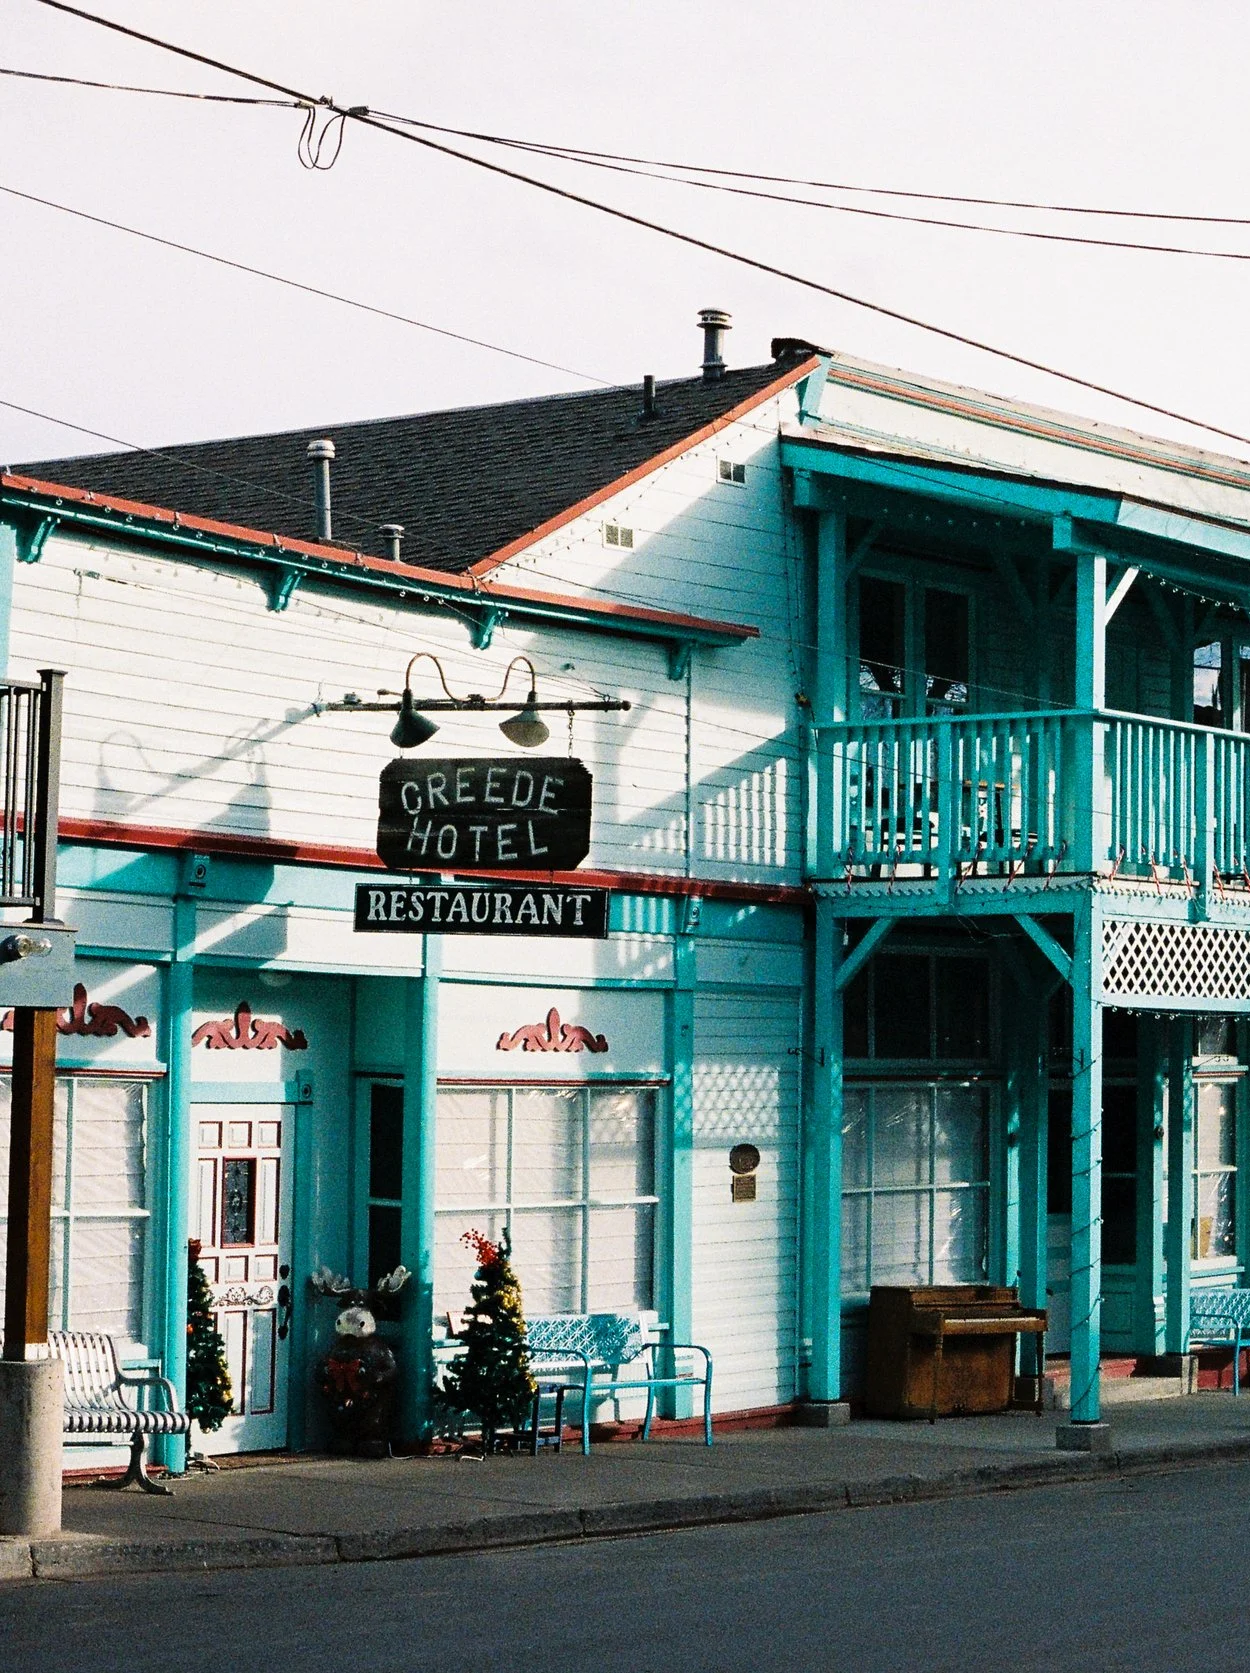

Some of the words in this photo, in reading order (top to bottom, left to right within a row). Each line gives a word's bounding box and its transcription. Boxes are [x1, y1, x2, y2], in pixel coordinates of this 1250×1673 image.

[401, 767, 565, 816] CREEDE
[406, 815, 549, 862] HOTEL
[366, 890, 592, 926] RESTAURANT
